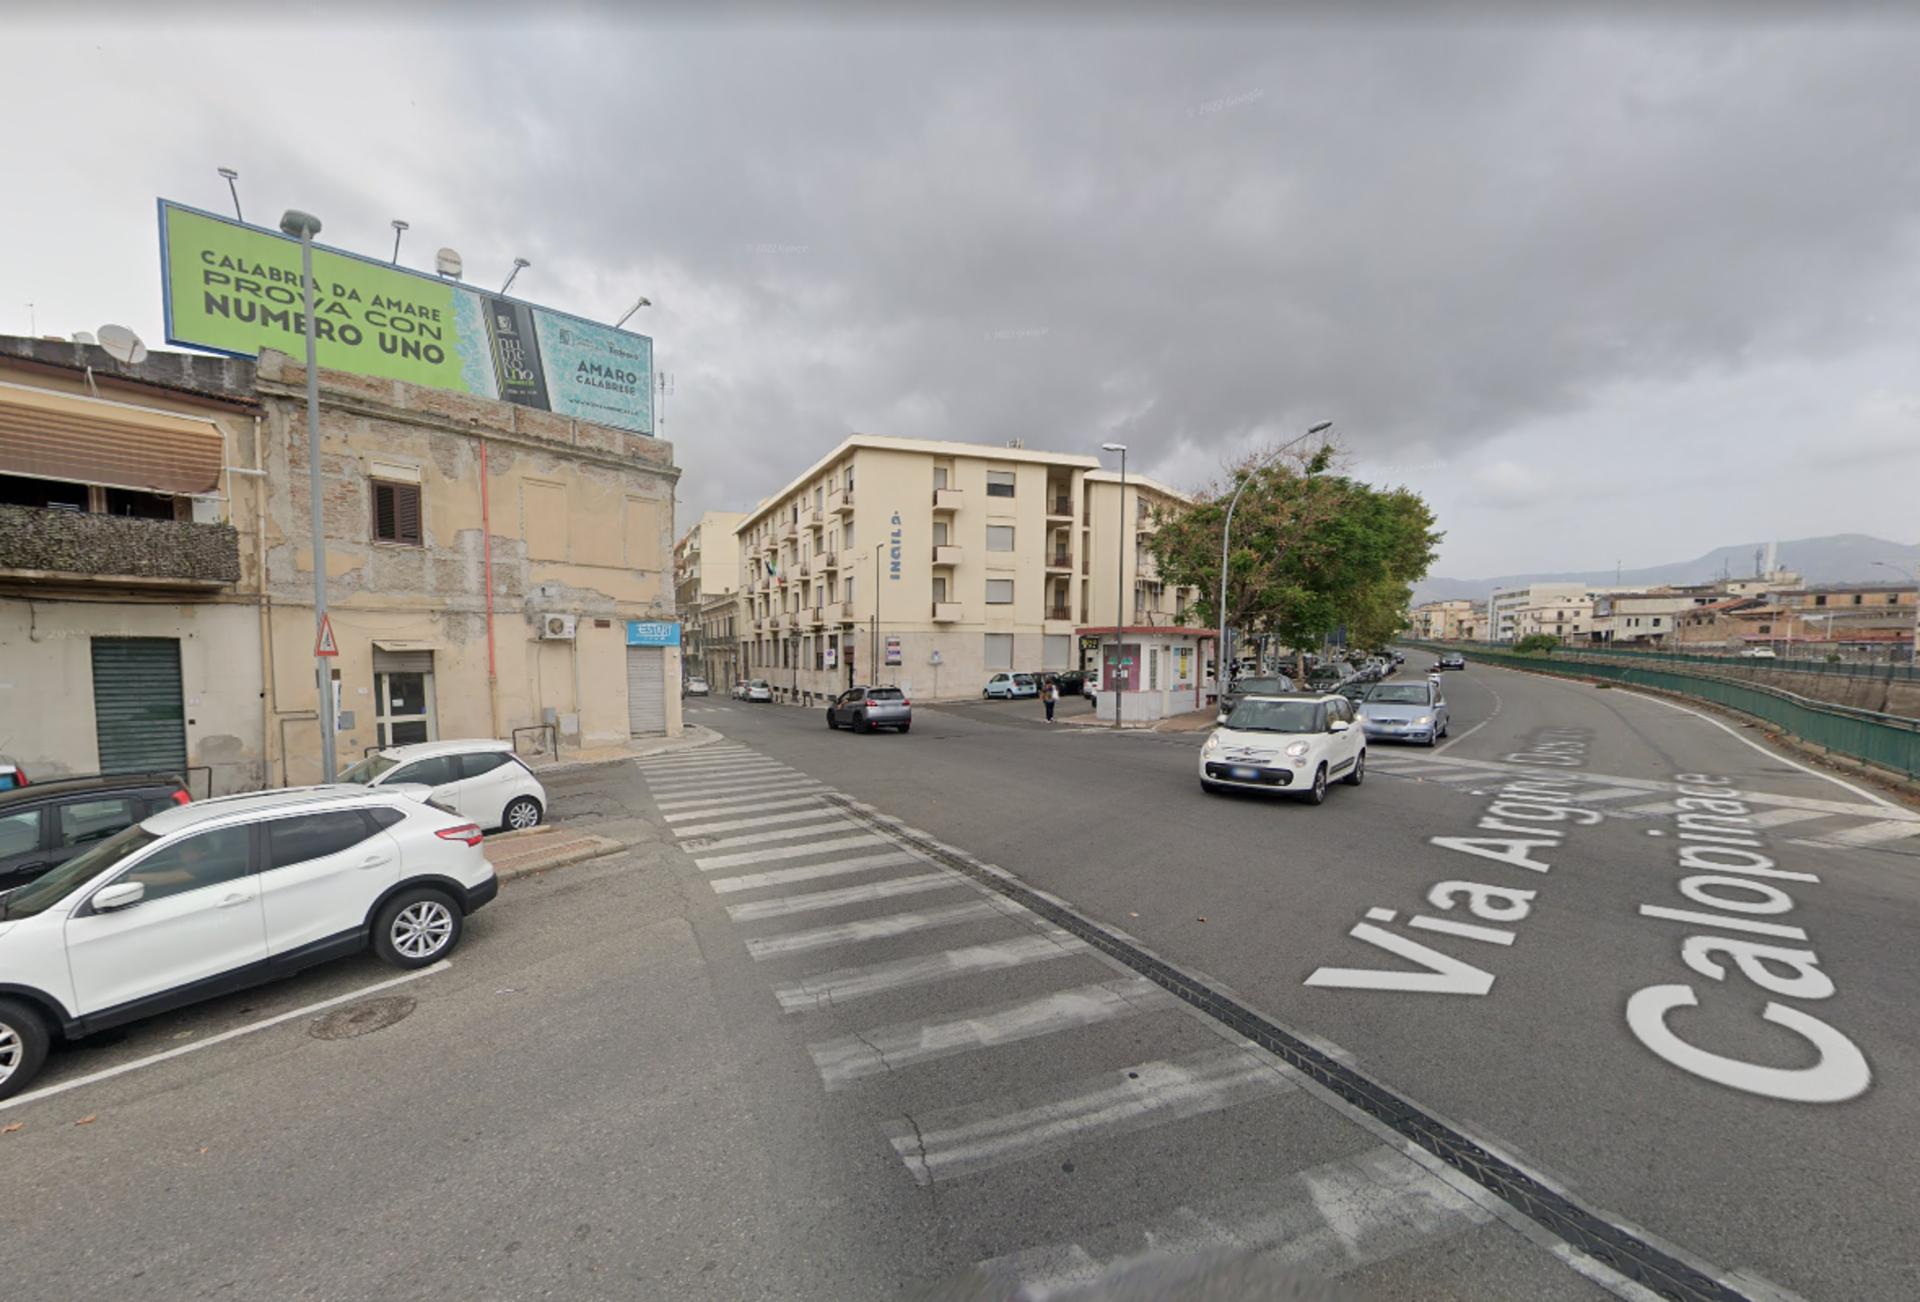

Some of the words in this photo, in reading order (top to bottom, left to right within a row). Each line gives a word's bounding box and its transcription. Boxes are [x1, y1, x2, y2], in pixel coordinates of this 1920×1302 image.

[201, 250, 322, 293] CALABRIA
[332, 283, 362, 303] DA
[371, 294, 441, 322] AMARE
[203, 269, 352, 320] PROVA
[364, 310, 442, 341] CON
[204, 291, 363, 346] NUMERO
[378, 331, 445, 365] UNO
[576, 375, 636, 396] CALABRESE
[577, 360, 637, 385] AMARO
